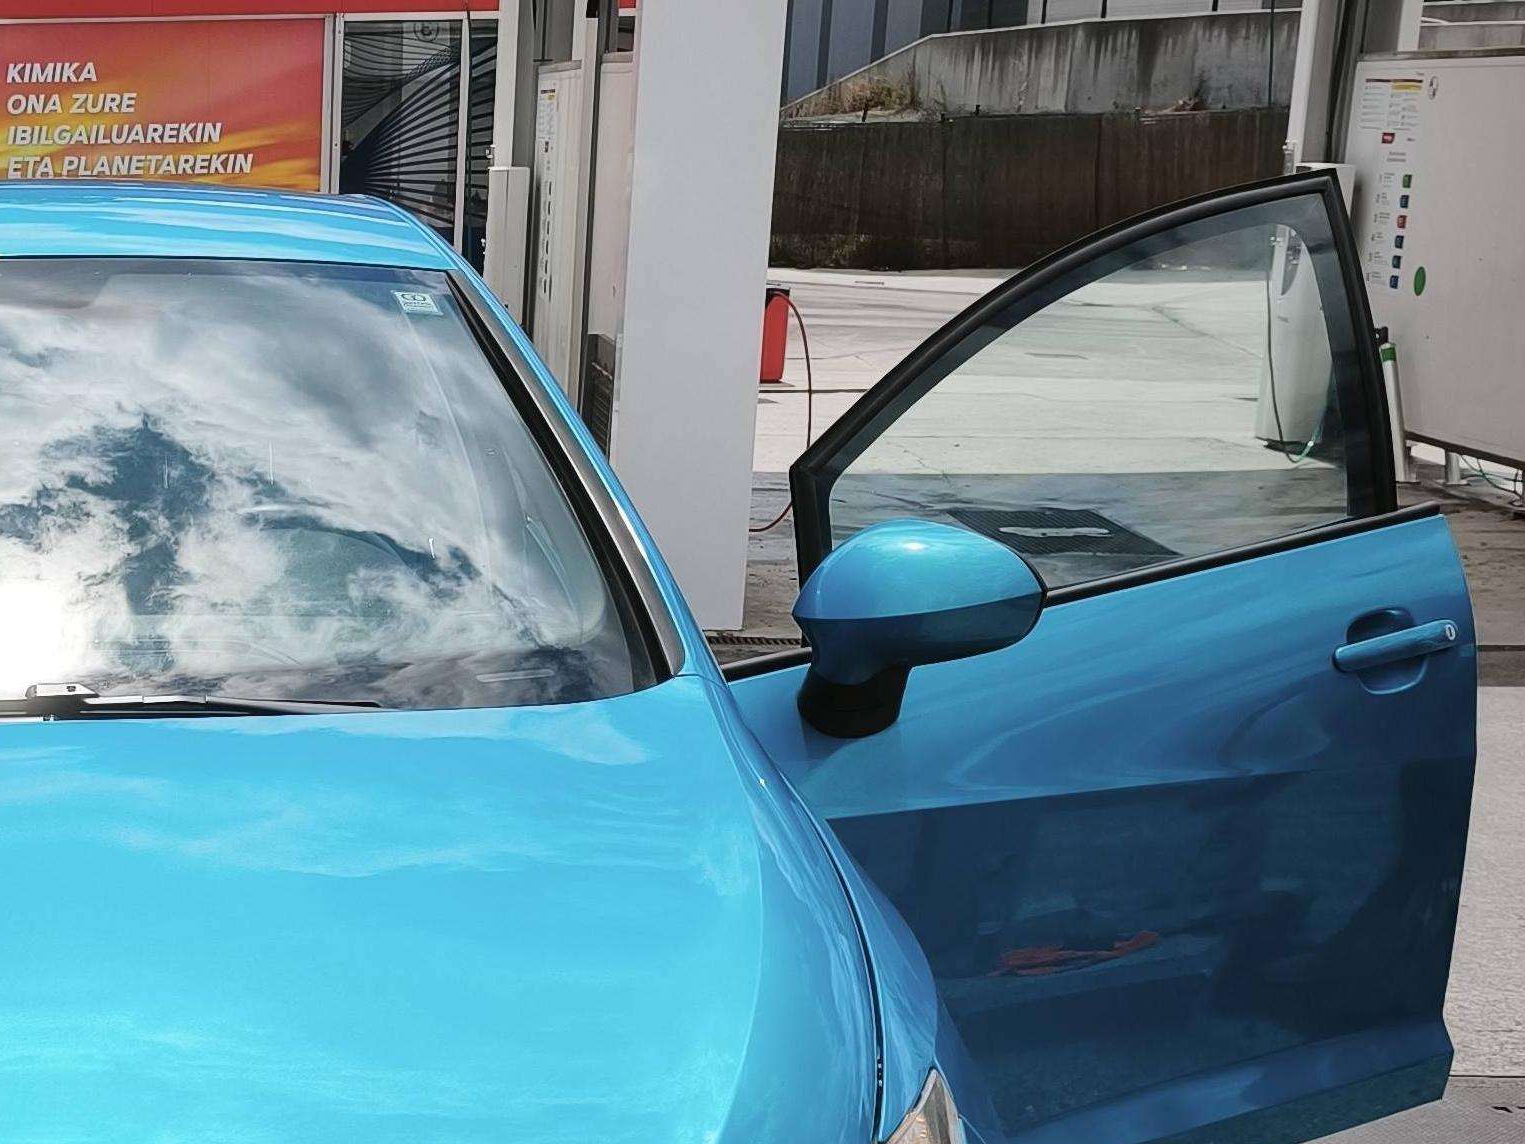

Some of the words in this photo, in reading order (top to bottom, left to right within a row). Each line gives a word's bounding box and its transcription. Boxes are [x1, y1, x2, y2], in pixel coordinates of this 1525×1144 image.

[6, 62, 98, 84] KIMIKA
[7, 94, 62, 115] ONA
[69, 93, 137, 114] ZURE
[7, 122, 222, 145] IBILGAILUAREKIN
[7, 156, 55, 179] ETA
[61, 153, 254, 178] PLANETAREKIN
